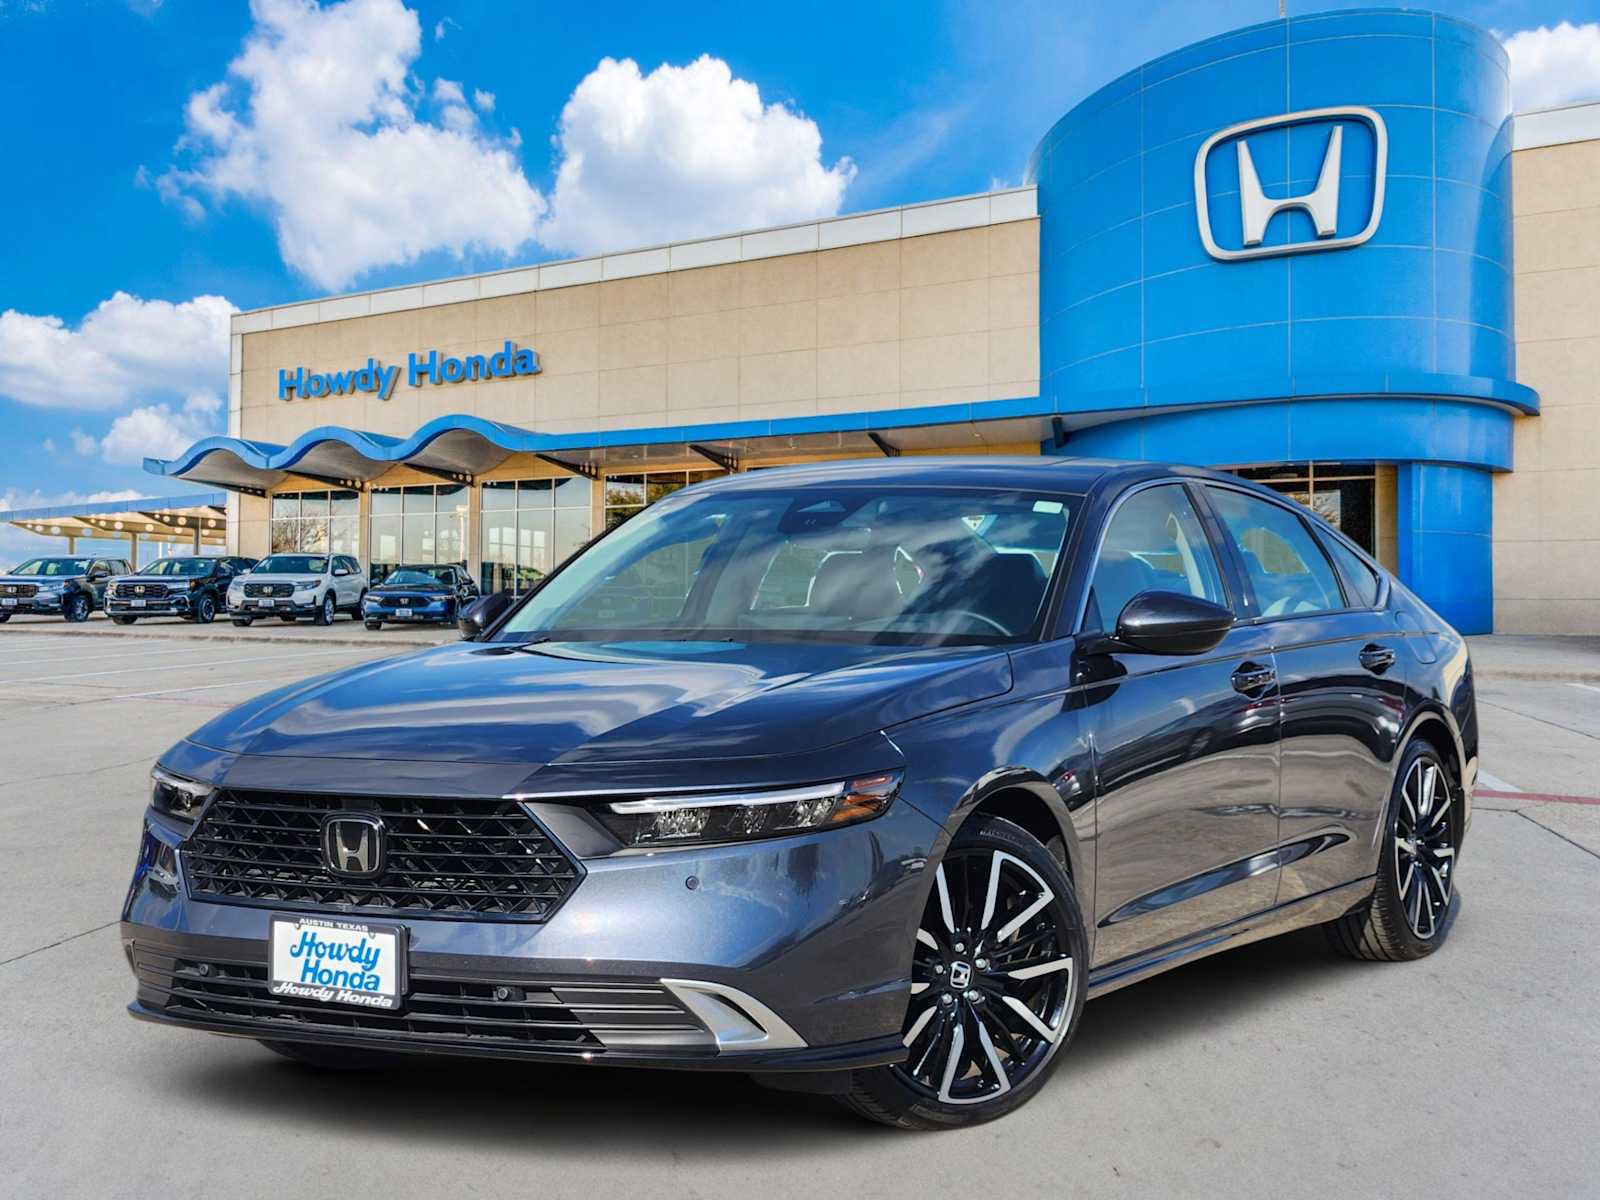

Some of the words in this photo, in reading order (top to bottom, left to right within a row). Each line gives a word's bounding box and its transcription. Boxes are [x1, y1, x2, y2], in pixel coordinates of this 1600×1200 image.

[278, 358, 400, 400] Howdy
[408, 341, 541, 386] Honda
[299, 918, 334, 927] AUSTIN
[336, 922, 369, 931] TEXAS
[290, 931, 381, 971] Howdy
[301, 959, 381, 991] Honda
[273, 982, 333, 1001] Howdy
[336, 990, 393, 1007] Honda
